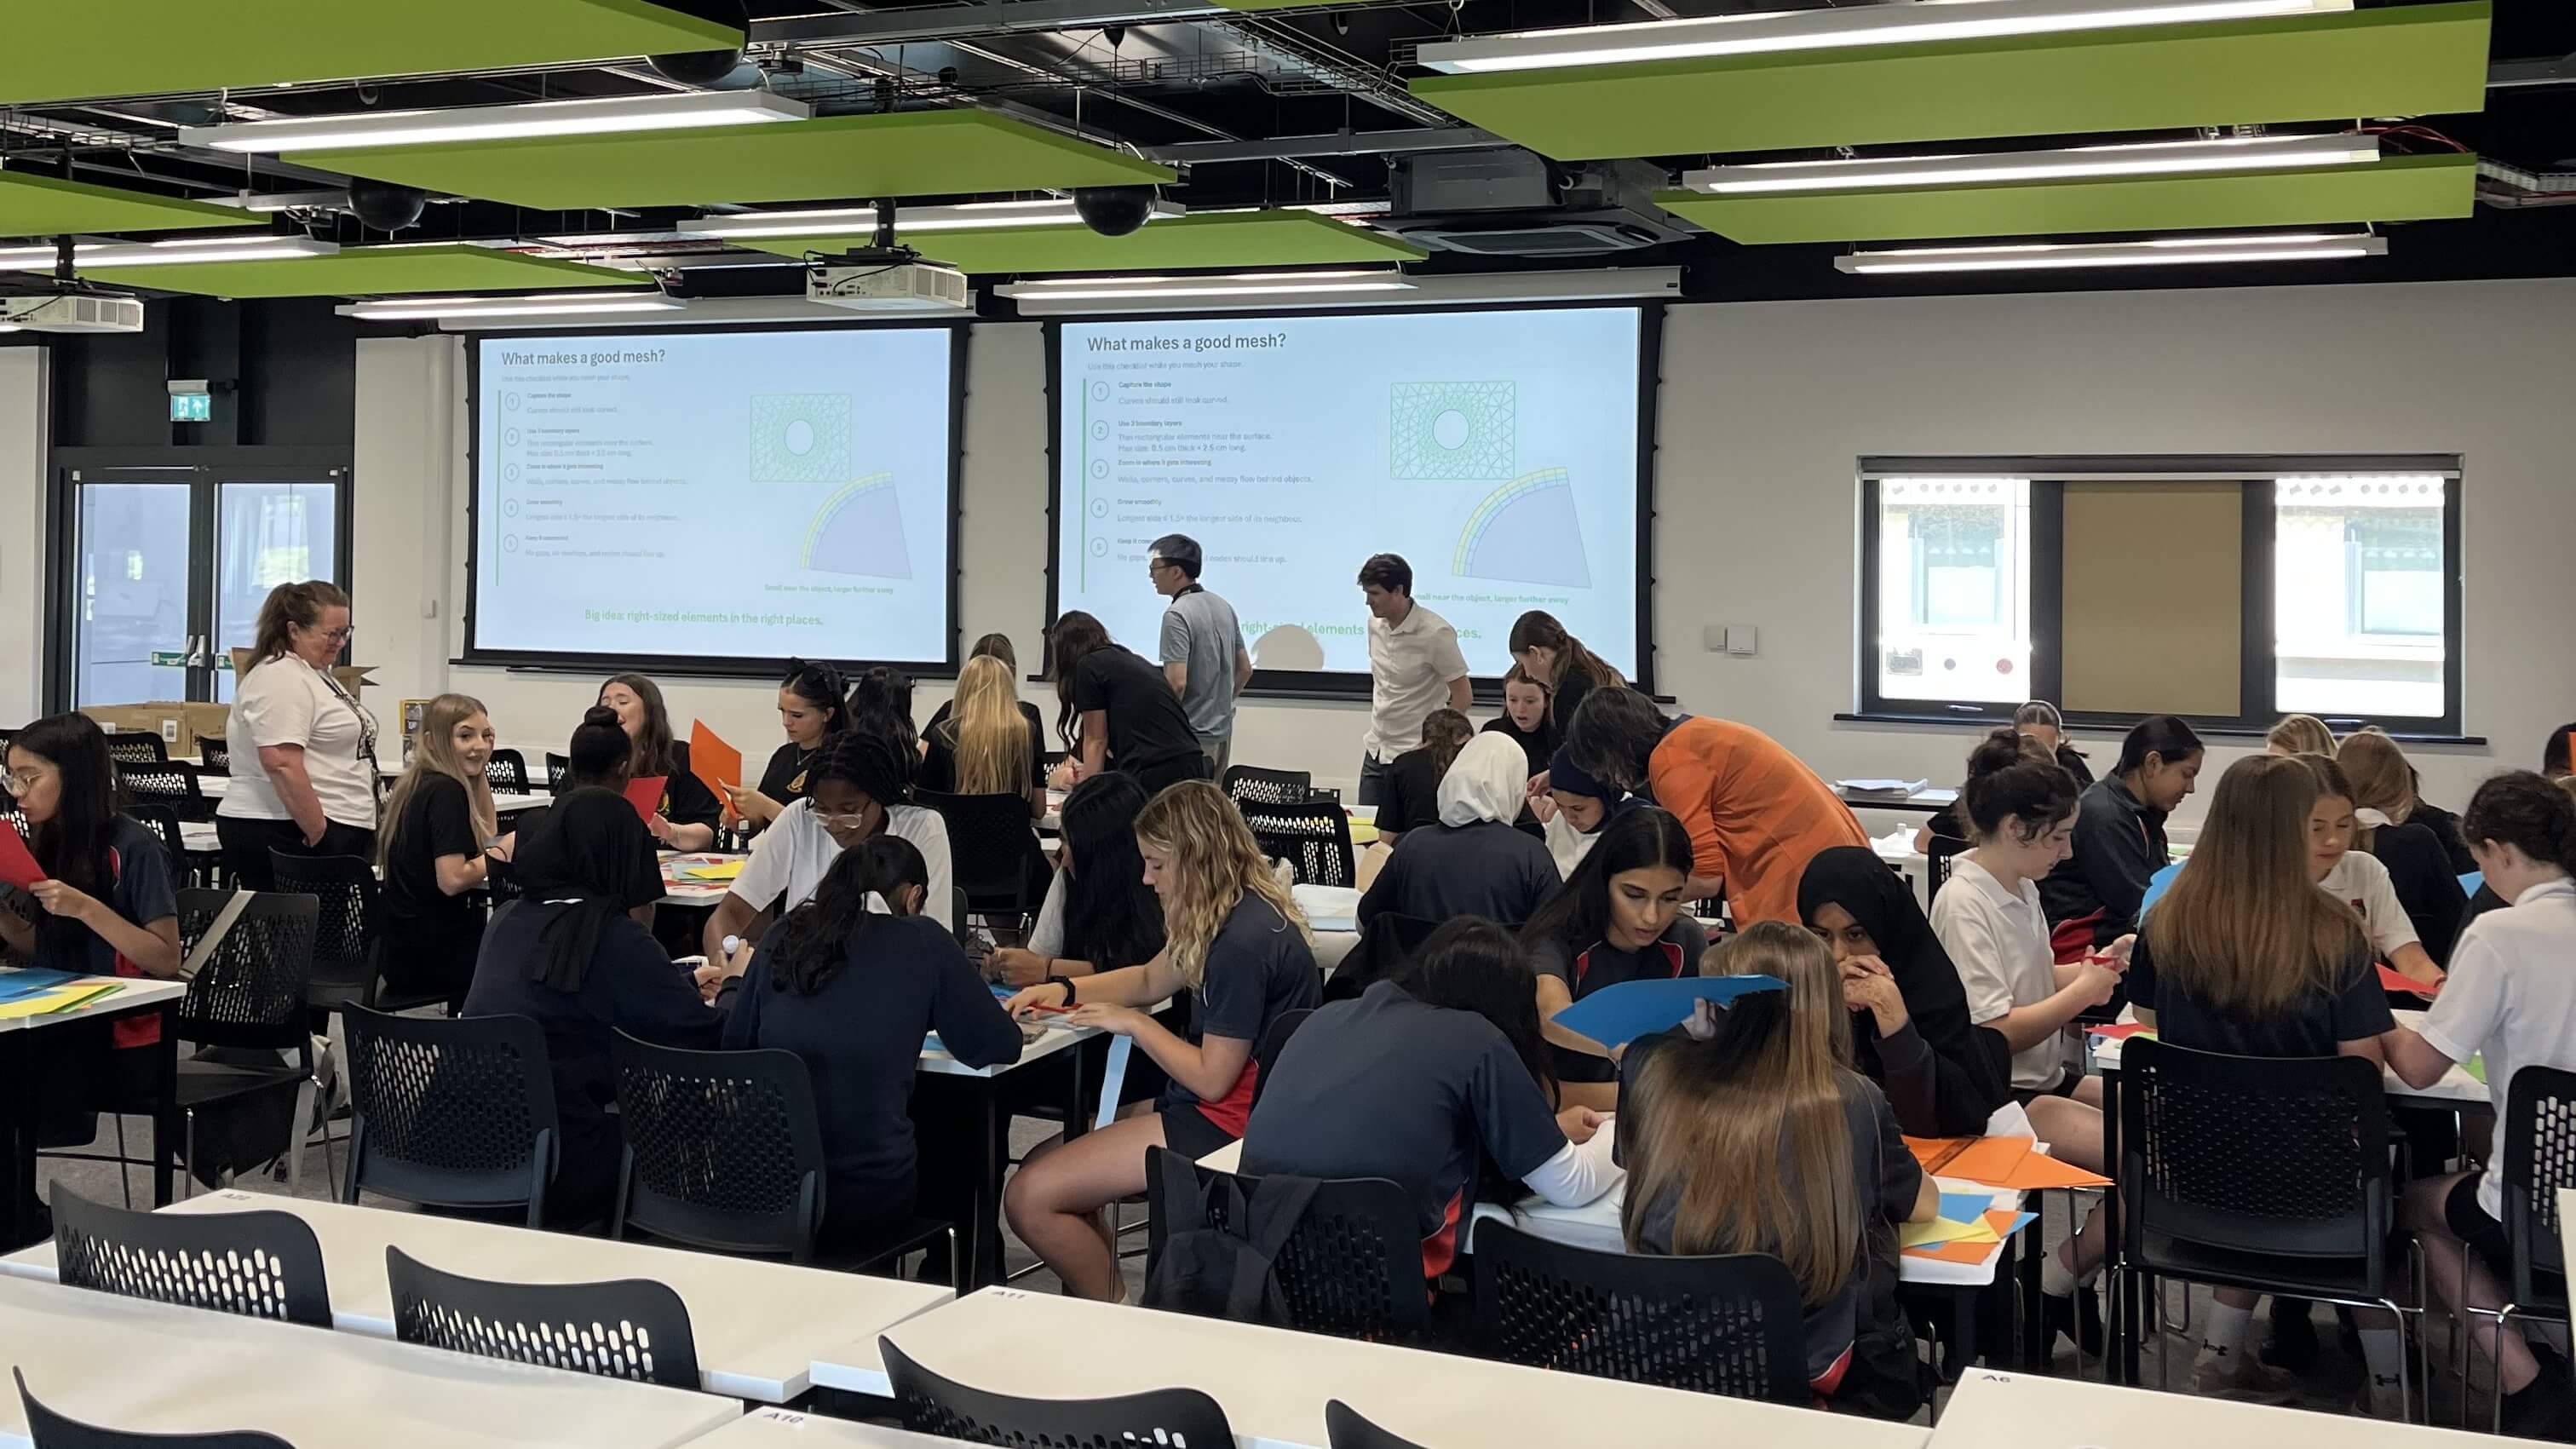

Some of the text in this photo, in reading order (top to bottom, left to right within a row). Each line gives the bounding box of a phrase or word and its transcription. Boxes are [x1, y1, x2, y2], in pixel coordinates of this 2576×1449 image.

[1088, 333, 1285, 352] What makes a good mesh?
[502, 349, 665, 366] What makes a good mesh?
[1466, 595, 1492, 603] object,
[585, 609, 823, 627] Big idea: right-sized elements in the right places.
[1308, 623, 1364, 635] elements
[763, 1412, 803, 1423] A10
